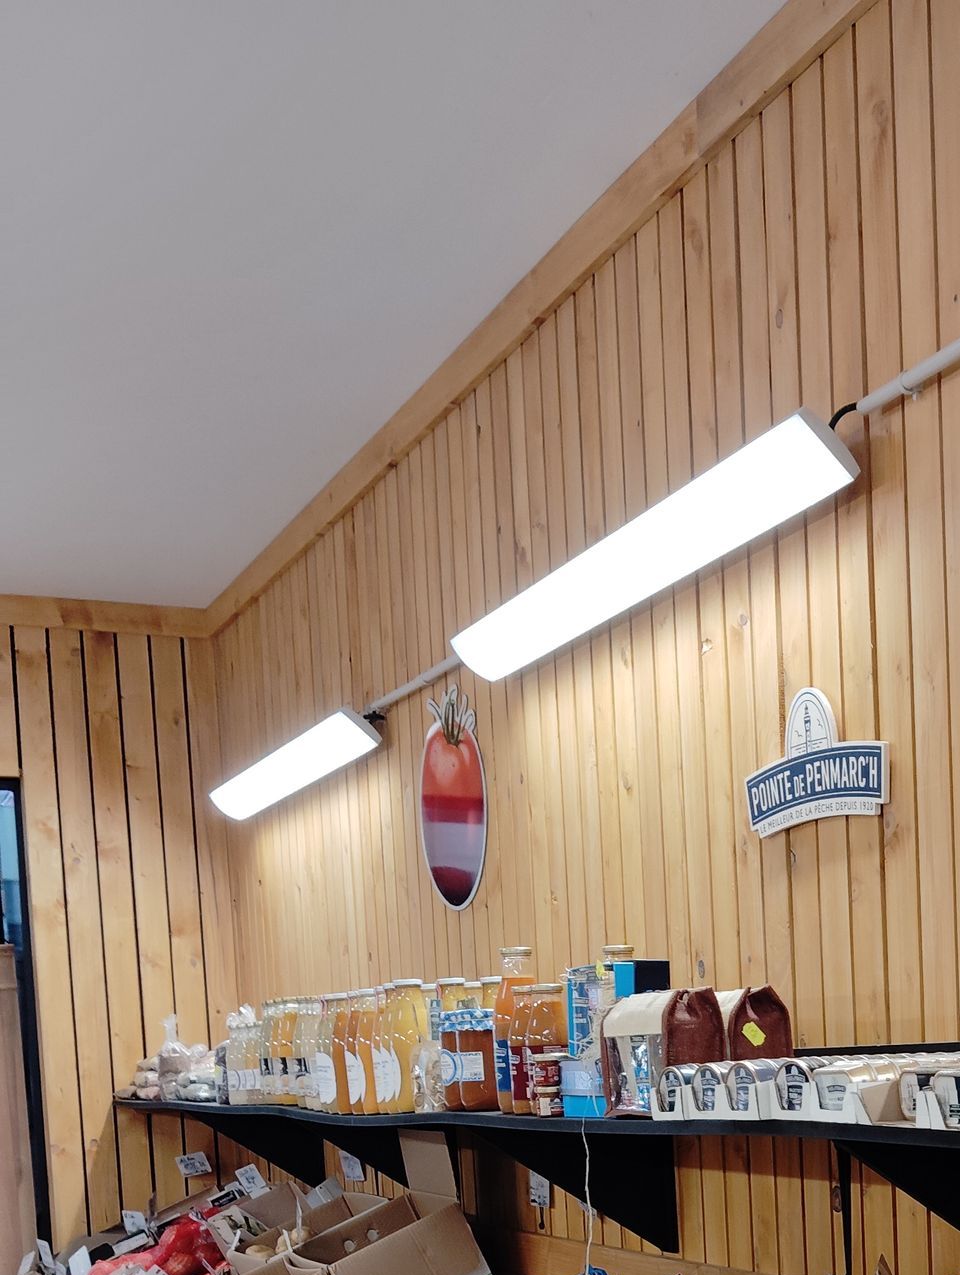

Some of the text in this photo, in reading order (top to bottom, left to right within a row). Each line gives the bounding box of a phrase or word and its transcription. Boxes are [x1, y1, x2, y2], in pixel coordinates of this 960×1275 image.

[751, 756, 878, 816] POINTE DE PENMARC'H
[760, 800, 874, 834] LE MEILLEUR DE LA PÊCHE DEPUIS 1920
